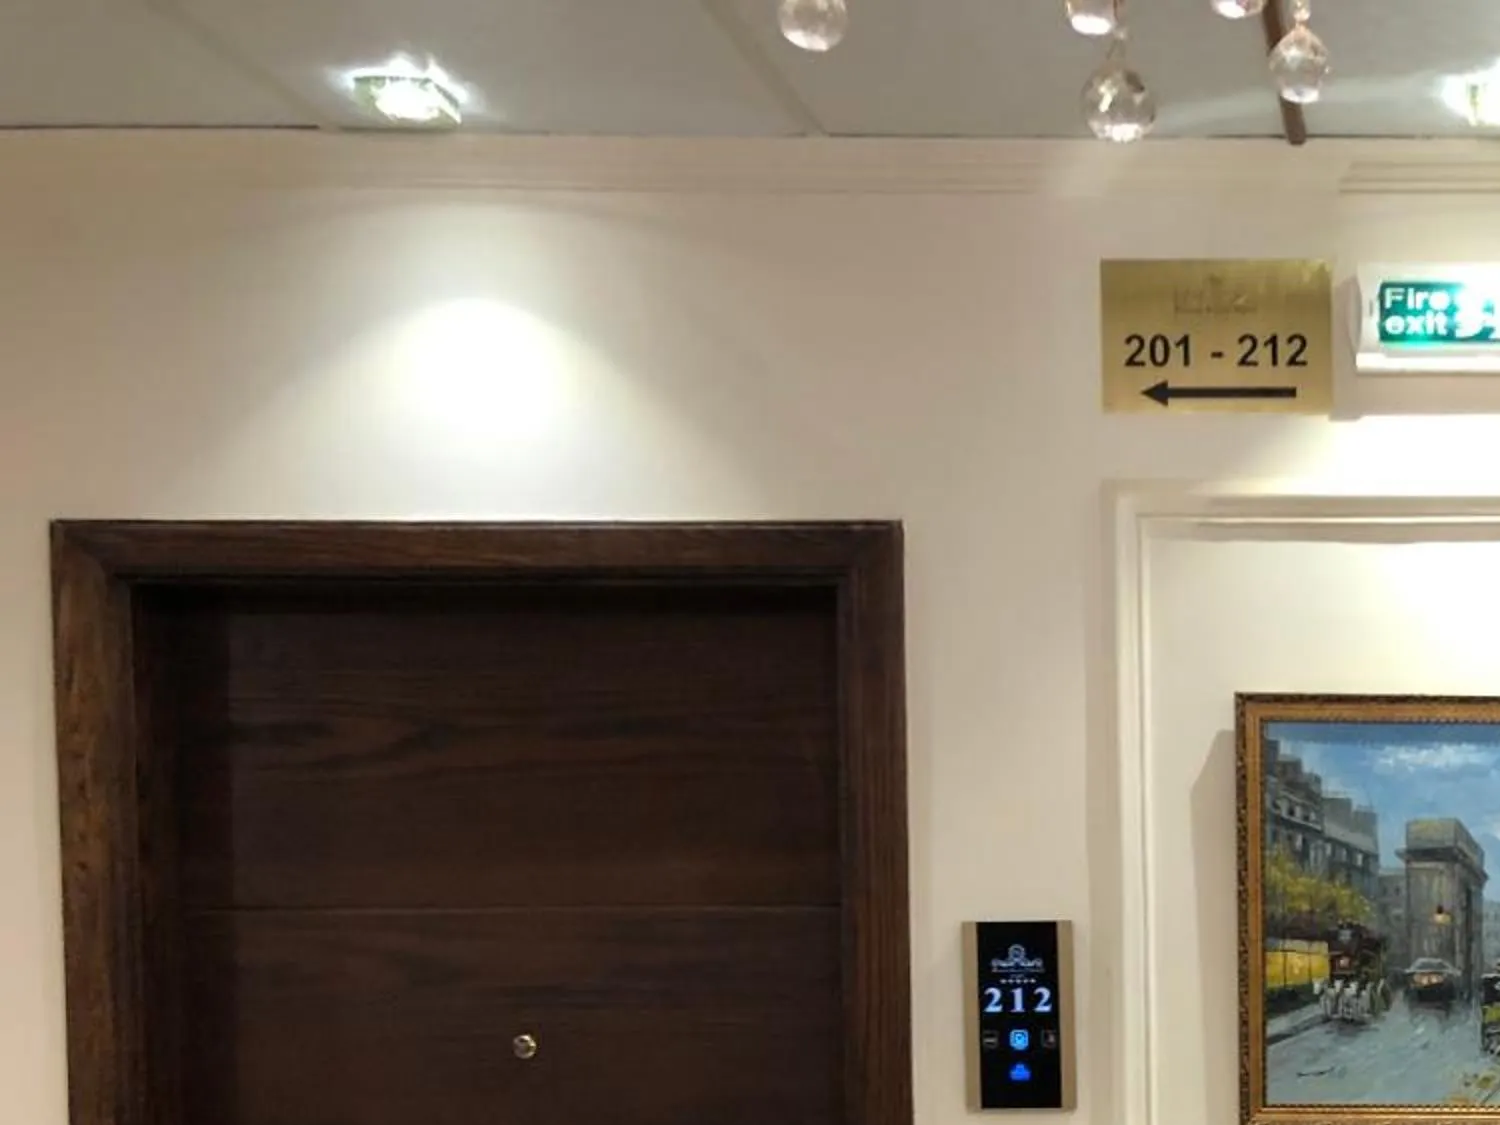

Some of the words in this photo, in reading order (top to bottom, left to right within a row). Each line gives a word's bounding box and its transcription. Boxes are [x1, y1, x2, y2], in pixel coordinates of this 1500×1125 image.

[1384, 287, 1451, 310] Fire
[1384, 310, 1449, 336] exit
[1124, 333, 1191, 367] 201
[1237, 333, 1308, 367] 212
[984, 987, 1052, 1012] 212
